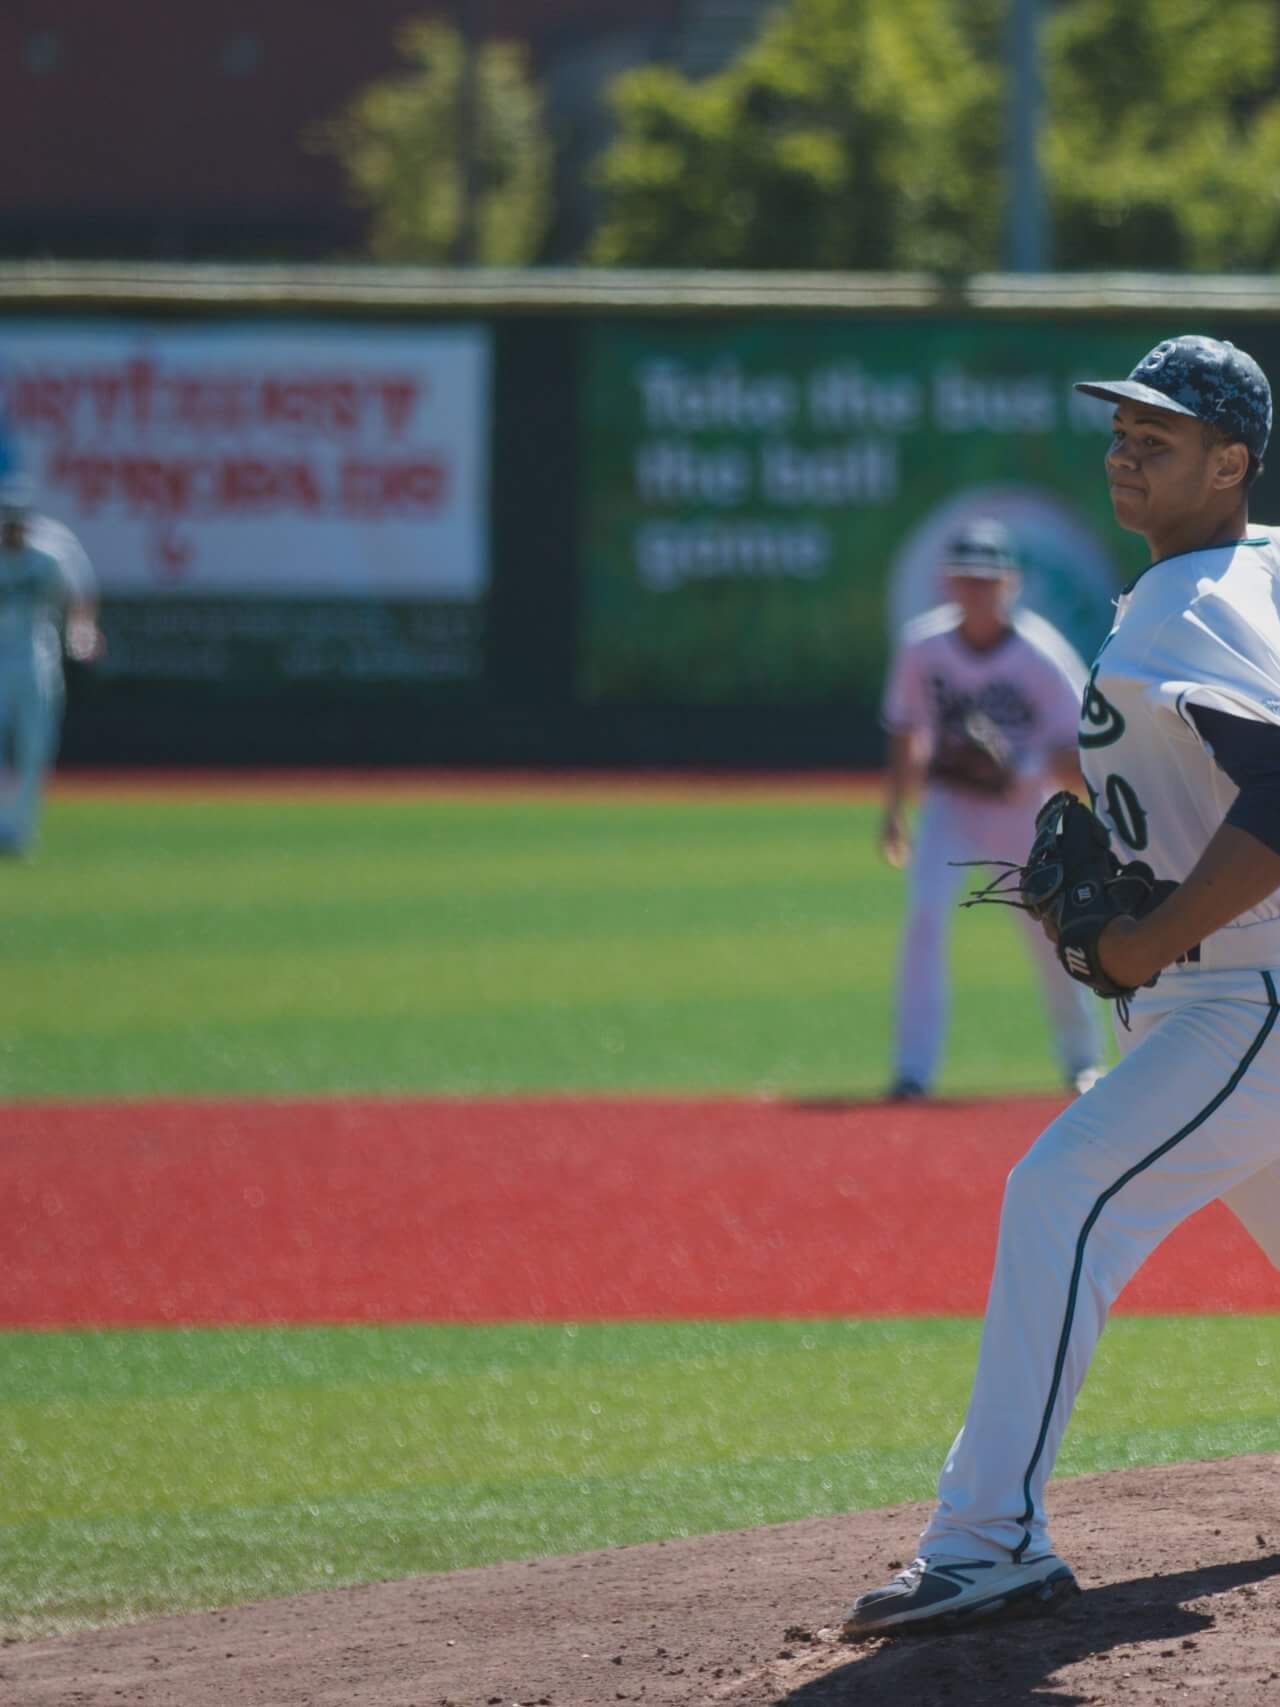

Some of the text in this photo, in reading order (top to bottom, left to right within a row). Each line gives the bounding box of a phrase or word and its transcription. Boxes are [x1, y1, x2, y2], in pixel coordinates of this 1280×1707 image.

[638, 358, 794, 430] Take
[808, 360, 918, 432] the
[932, 364, 1054, 432] bus
[636, 438, 896, 500] the ball
[636, 524, 830, 590] game
